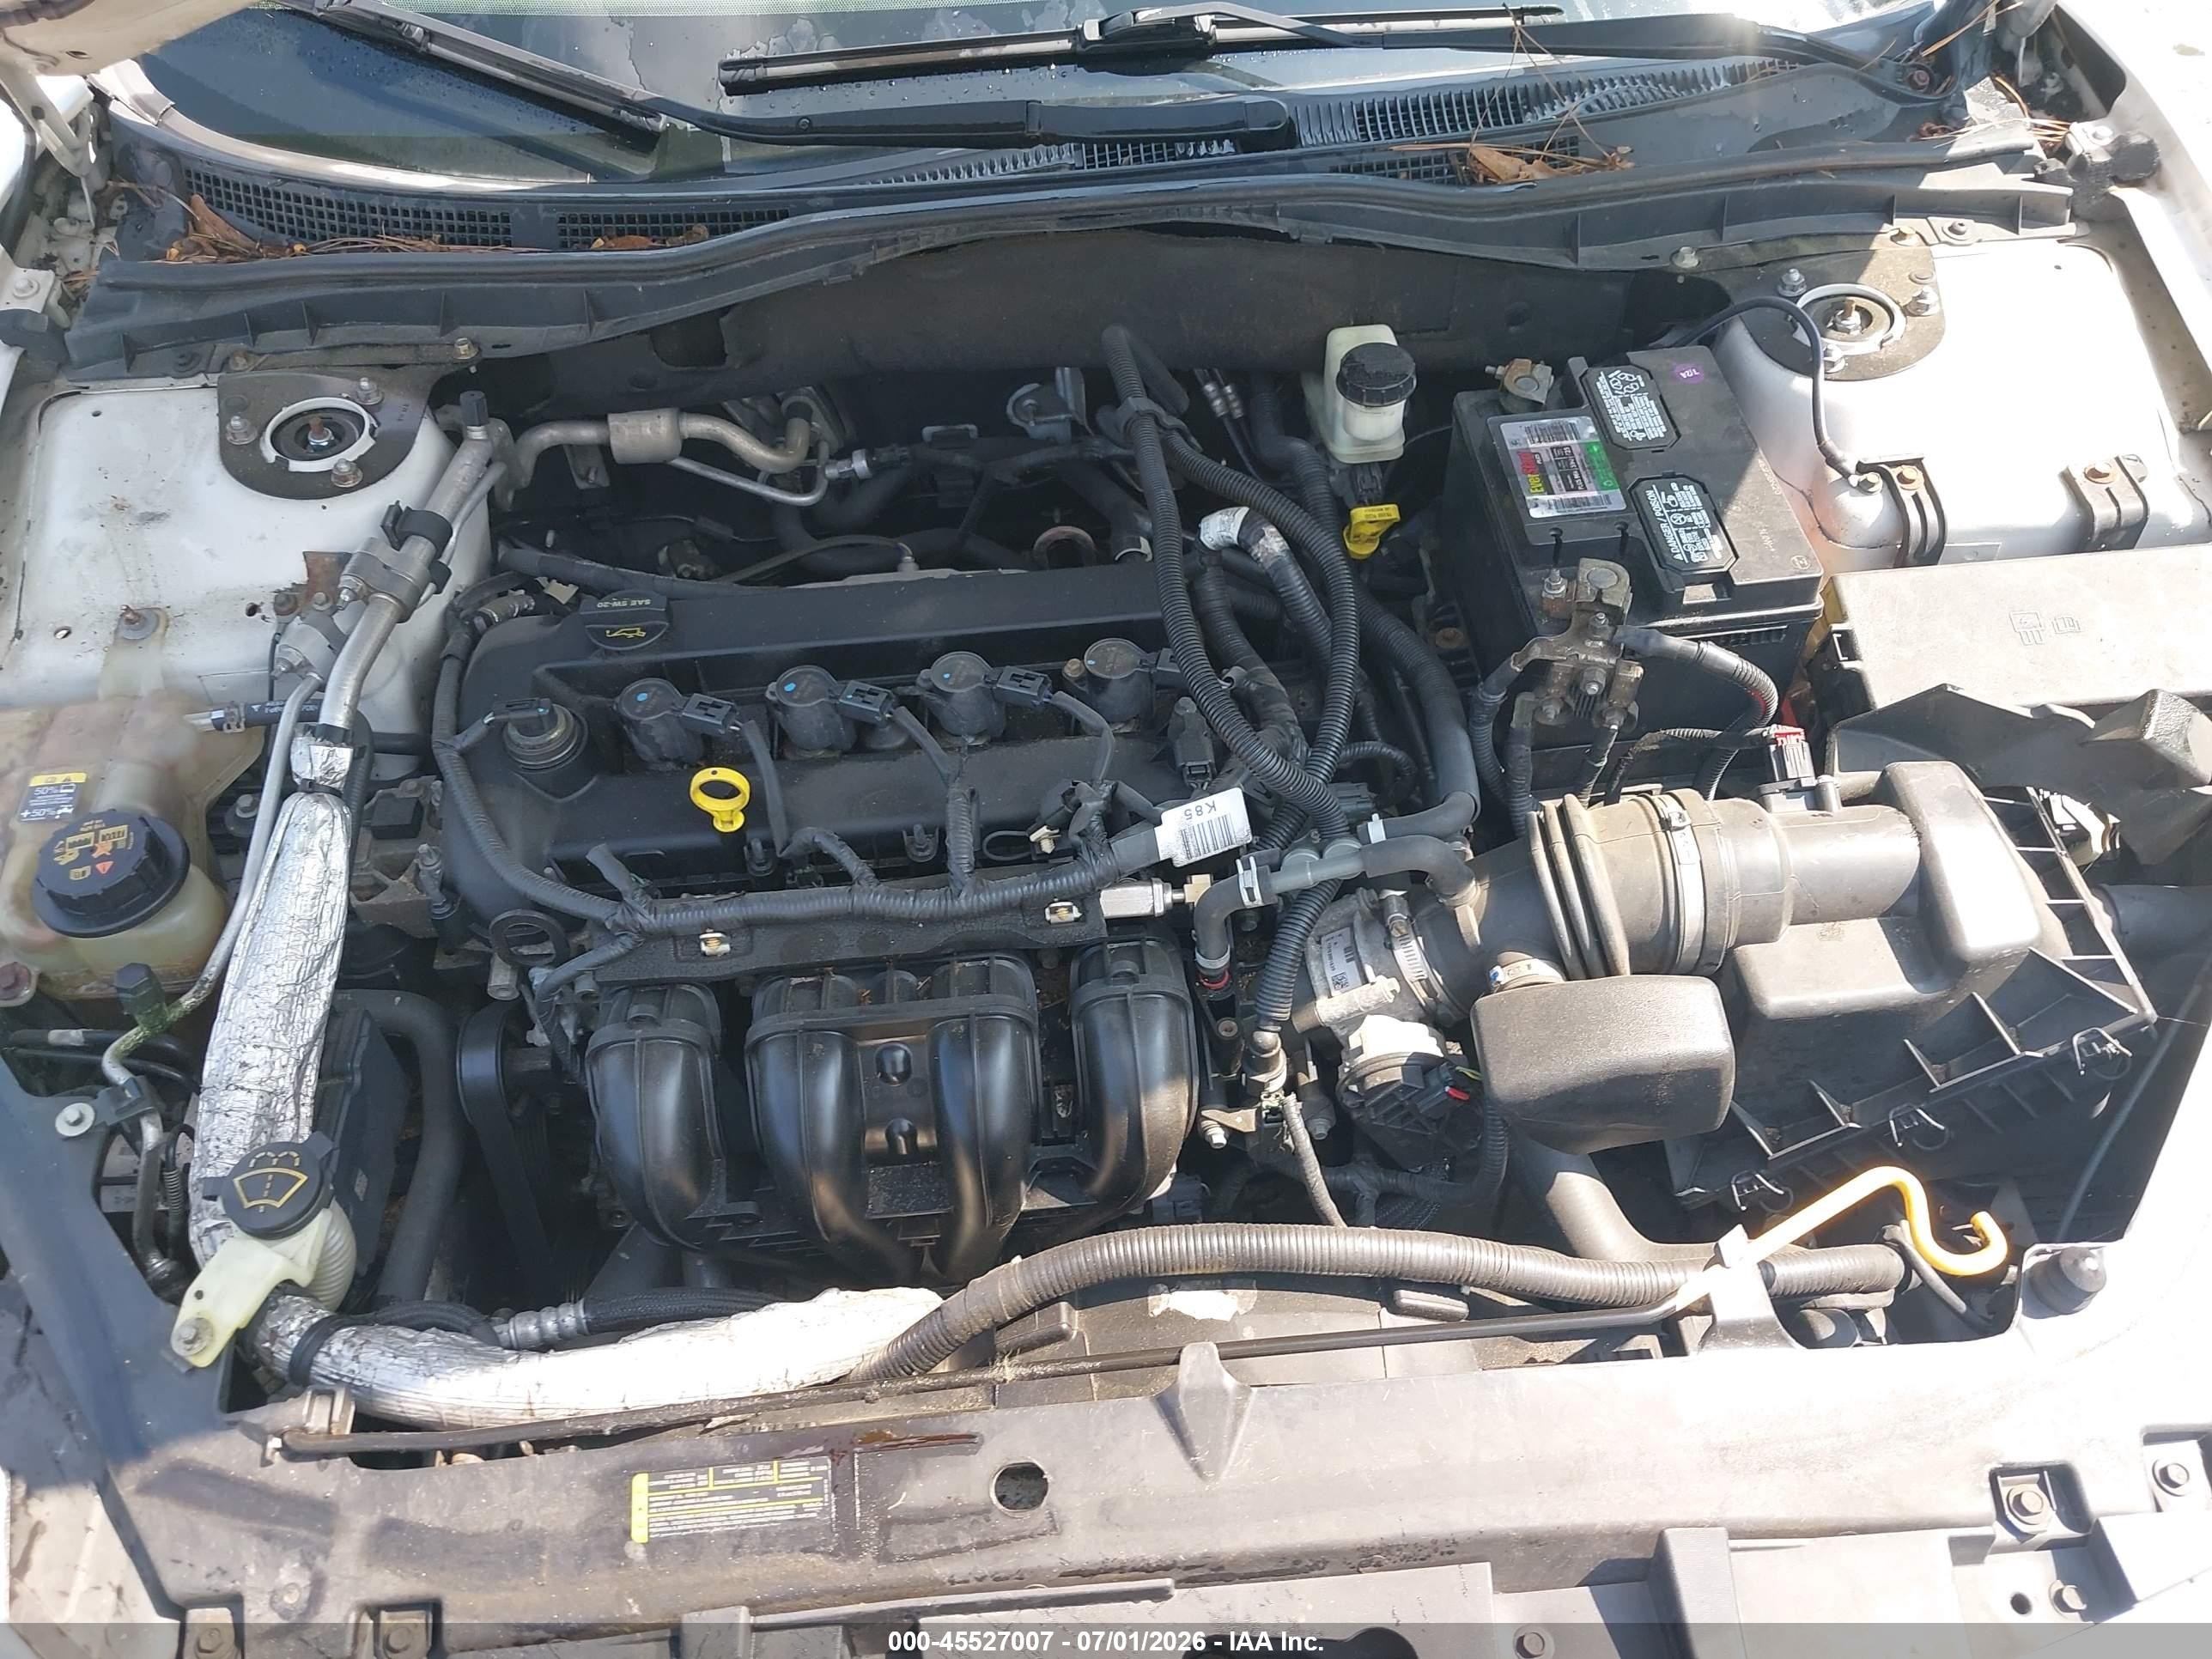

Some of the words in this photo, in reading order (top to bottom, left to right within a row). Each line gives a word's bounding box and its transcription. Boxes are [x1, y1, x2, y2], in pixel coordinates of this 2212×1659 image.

[1645, 489, 1665, 517] POISON
[1660, 523, 1680, 553] DANGER
[1184, 799, 1217, 820] K85
